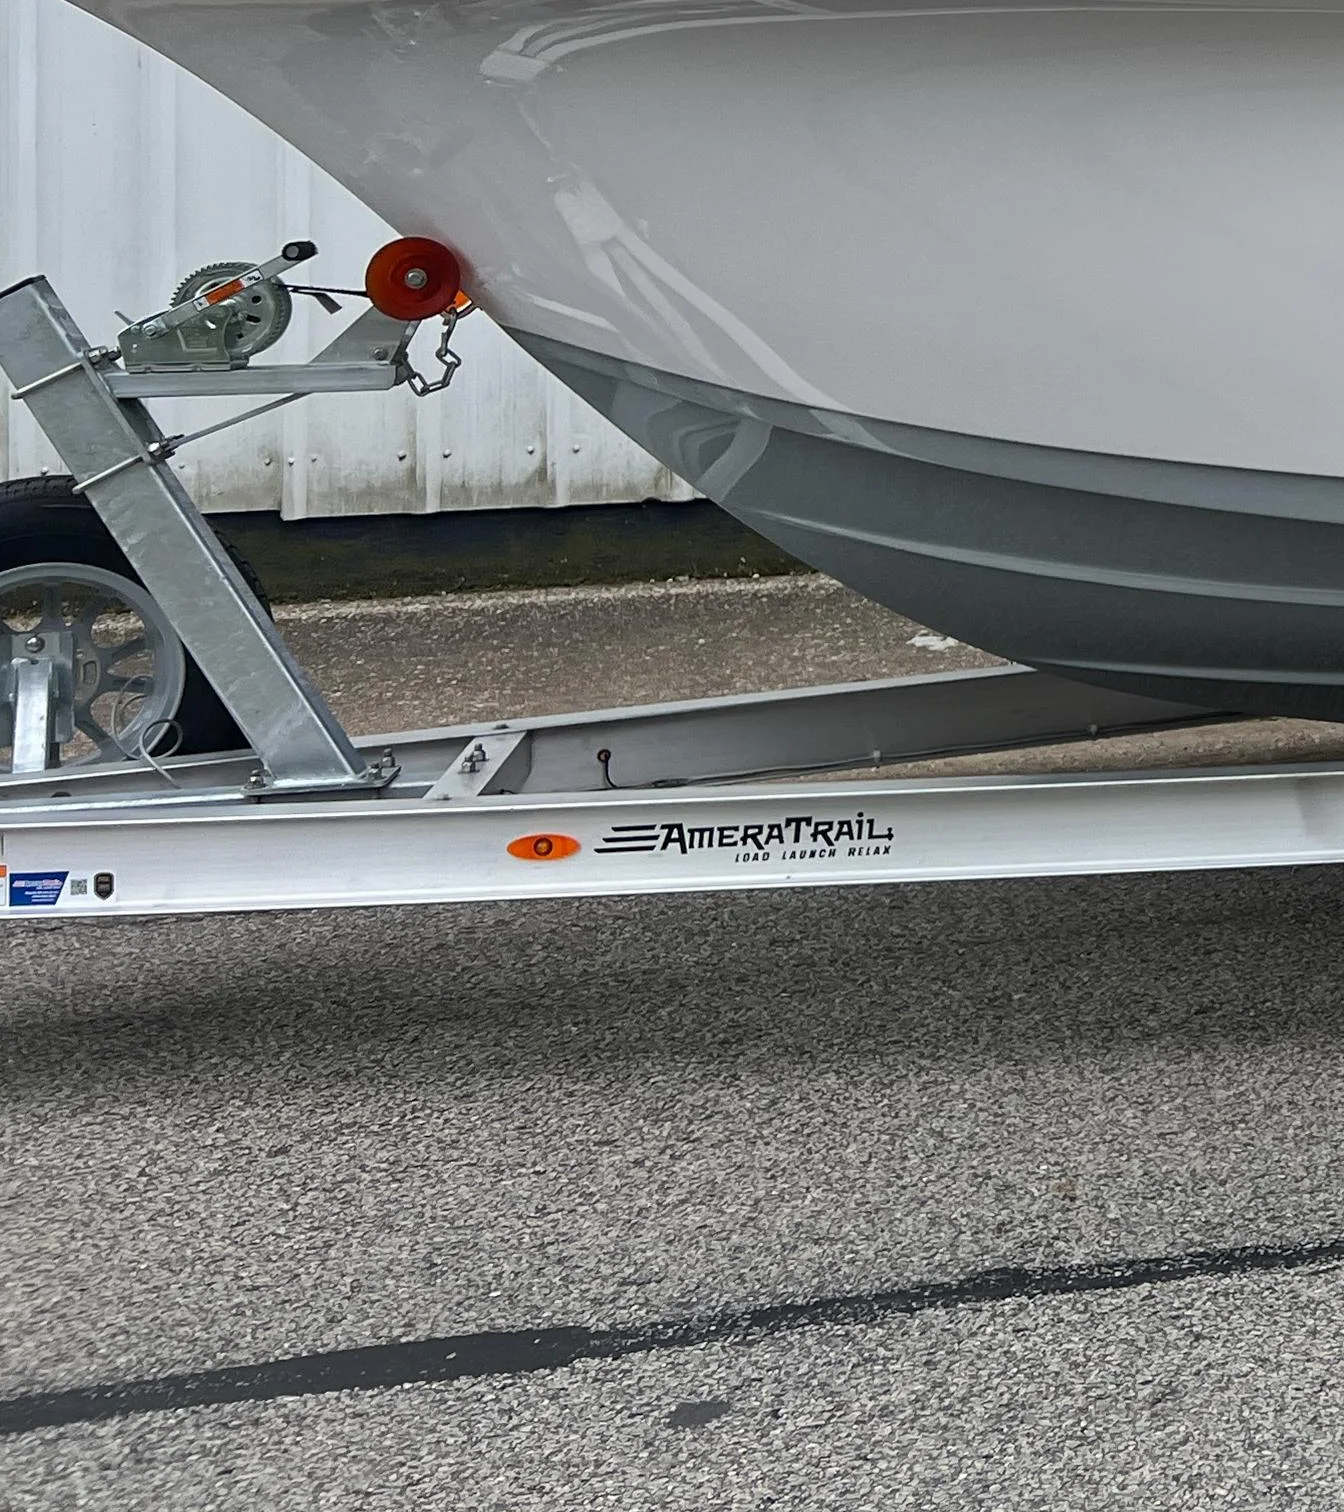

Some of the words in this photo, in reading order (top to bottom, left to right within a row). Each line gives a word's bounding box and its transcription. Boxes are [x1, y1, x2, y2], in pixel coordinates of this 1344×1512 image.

[734, 852, 771, 863] LOAD
[781, 848, 837, 861] LAUNCH
[847, 845, 892, 857] RELAX
